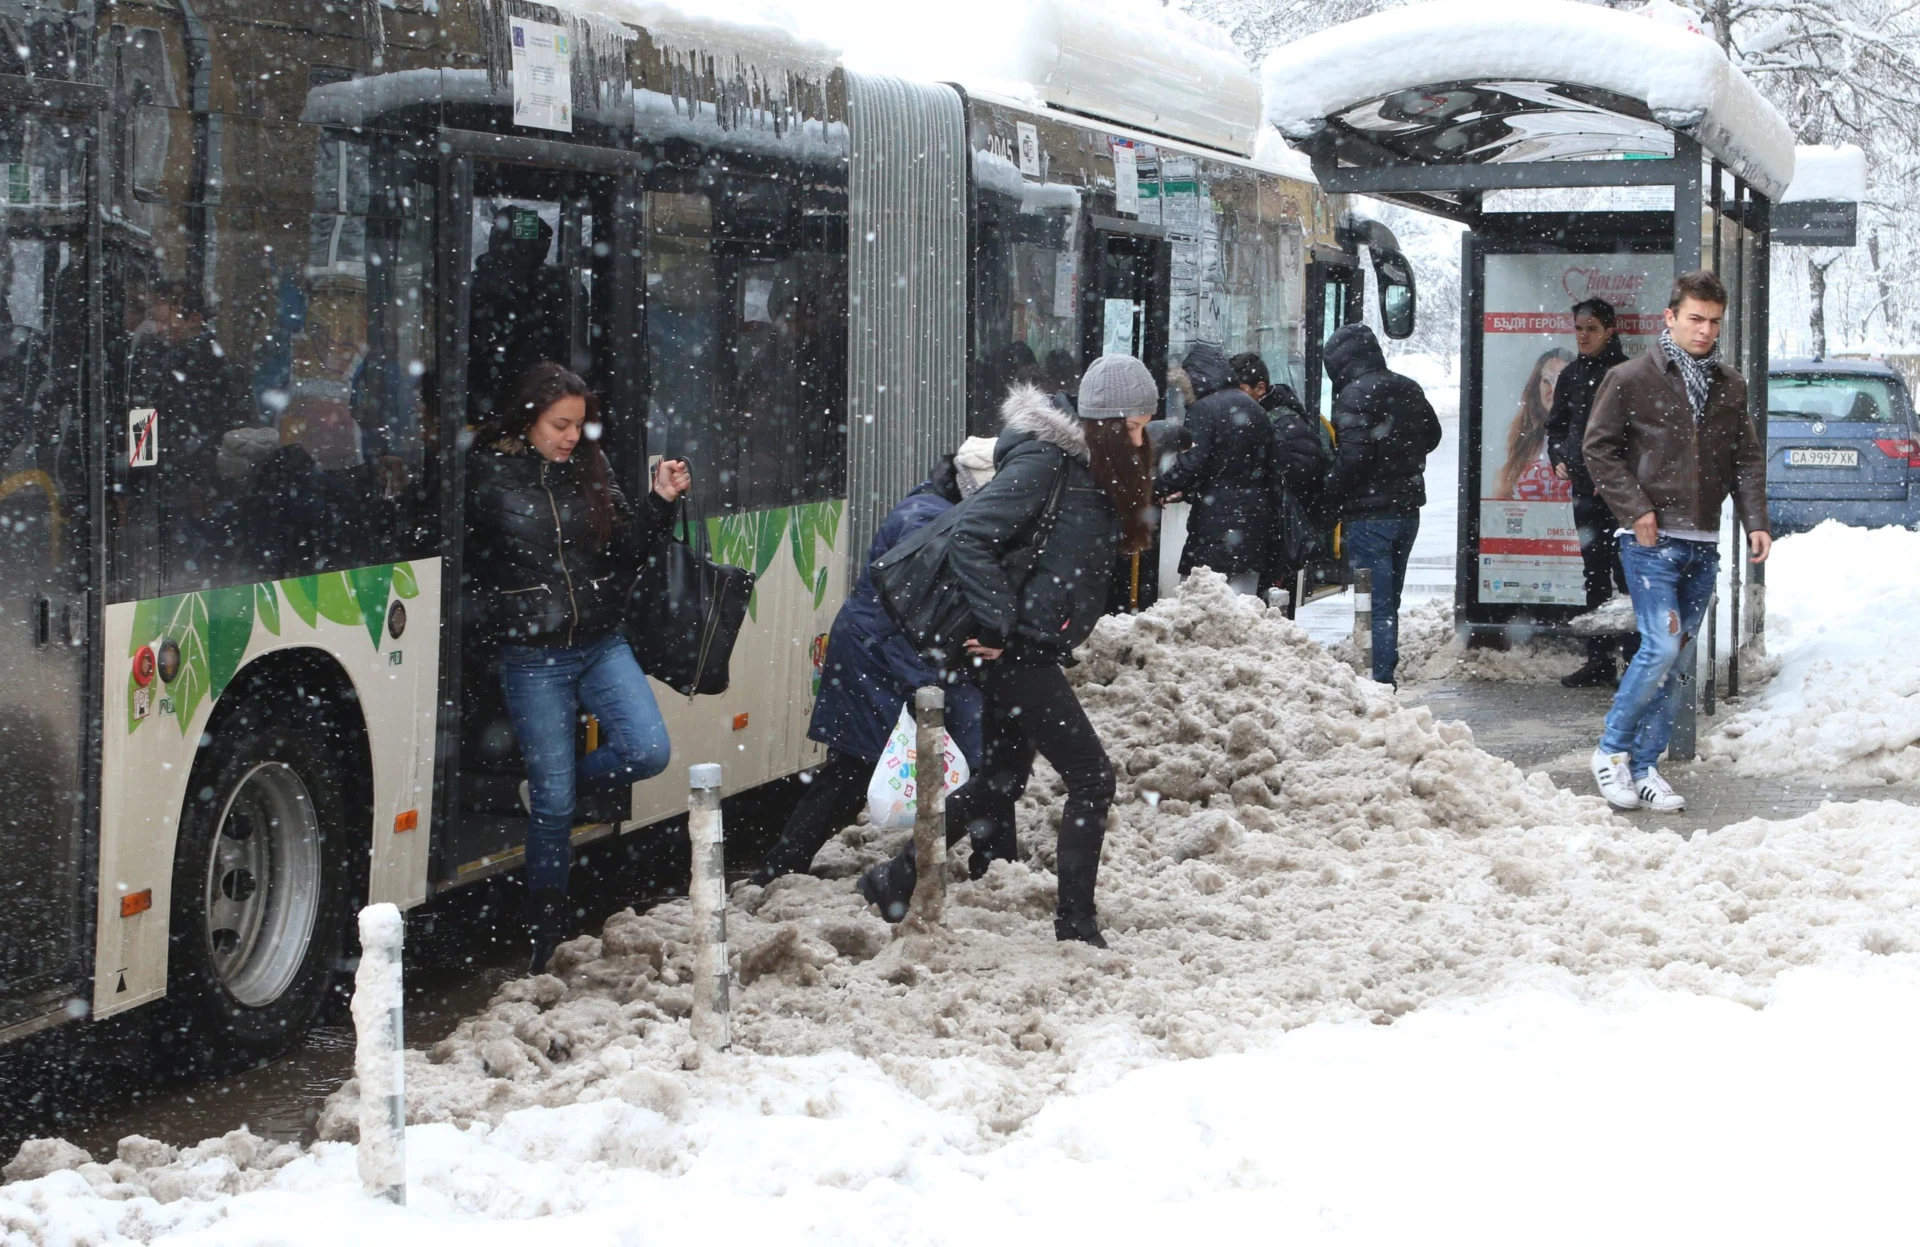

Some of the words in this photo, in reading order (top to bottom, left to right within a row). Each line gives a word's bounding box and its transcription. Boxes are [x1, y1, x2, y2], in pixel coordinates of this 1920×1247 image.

[1493, 317, 1526, 330] БЪДИ
[1529, 316, 1565, 330] ГЕРОЙ
[1791, 452, 1808, 464] CA
[1809, 452, 1838, 464] 9997
[1840, 453, 1855, 464] XK
[1546, 528, 1565, 536] DMS
